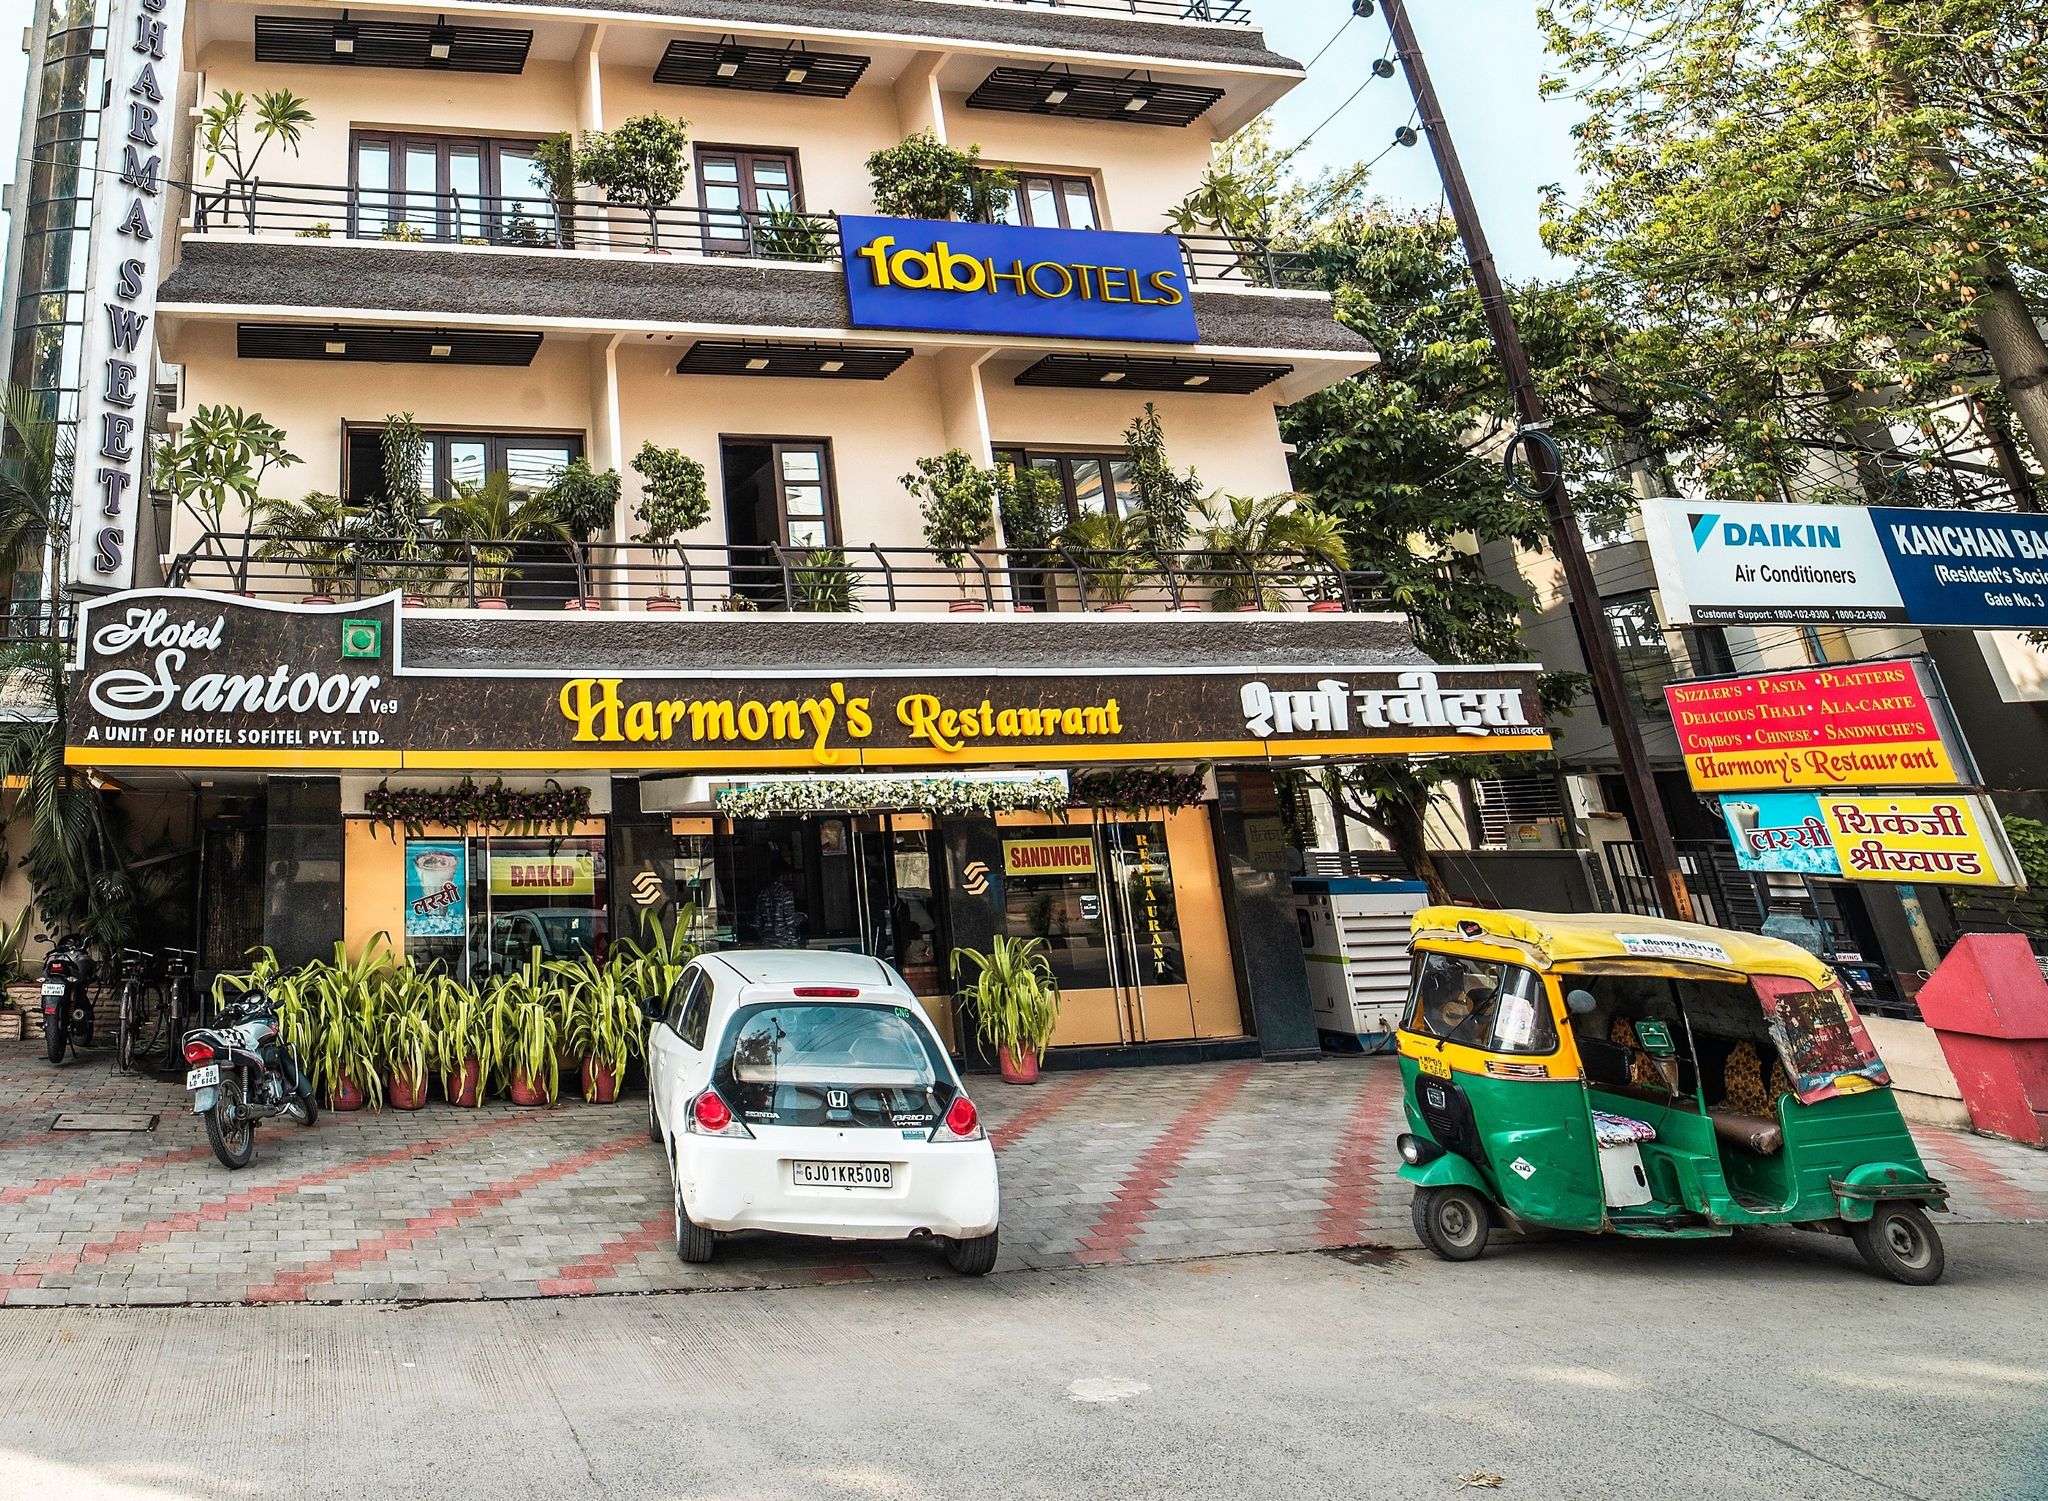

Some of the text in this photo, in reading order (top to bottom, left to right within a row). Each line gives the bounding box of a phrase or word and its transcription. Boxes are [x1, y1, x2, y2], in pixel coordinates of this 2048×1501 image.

[118, 0, 167, 241] HARMA
[95, 258, 148, 575] SWEETS
[1723, 523, 1841, 549] DAIKIN
[1890, 524, 2048, 559] KANCHAN BA
[1734, 564, 1857, 584] Air Conditioners
[1696, 609, 1736, 619] Customer
[1738, 609, 1773, 621] Support:
[1773, 610, 1830, 619] 1800-102-9300
[1984, 592, 2045, 607] Gate No. 3
[92, 607, 226, 655] Hotel
[88, 648, 398, 722] Santoor Veg
[1674, 669, 1905, 703] SIZZLER'S PASTA PLATTERS
[1240, 672, 1530, 738] शर्मा स्वीट्स
[1681, 695, 1916, 726] DELICIOUS THALI ALA-CARTE
[86, 726, 385, 745] A UNIT OF HOTEL SOFITEL PVT. LTD.
[559, 678, 1123, 765] Harmony's Restaurant
[1688, 721, 1926, 749] COMBO'S CHINESE SANDWICHE'S
[1695, 746, 1939, 783] Harmony's Restaurant
[1745, 816, 1832, 853] लस्सी
[1832, 805, 1968, 838] शिकंजी
[1010, 844, 1091, 868] SANDWICH
[1850, 840, 1982, 875] श्रीखण्ड
[510, 865, 575, 887] BAKED
[411, 881, 461, 915] लस्सी
[1136, 834, 1166, 974] RESTAURANT
[1642, 938, 1723, 954] Money4Drive
[894, 1007, 910, 1018] CNG
[745, 1110, 780, 1119] HONDA
[804, 1165, 890, 1183] GJ01KR5008
[1514, 1164, 1531, 1173] CNG
